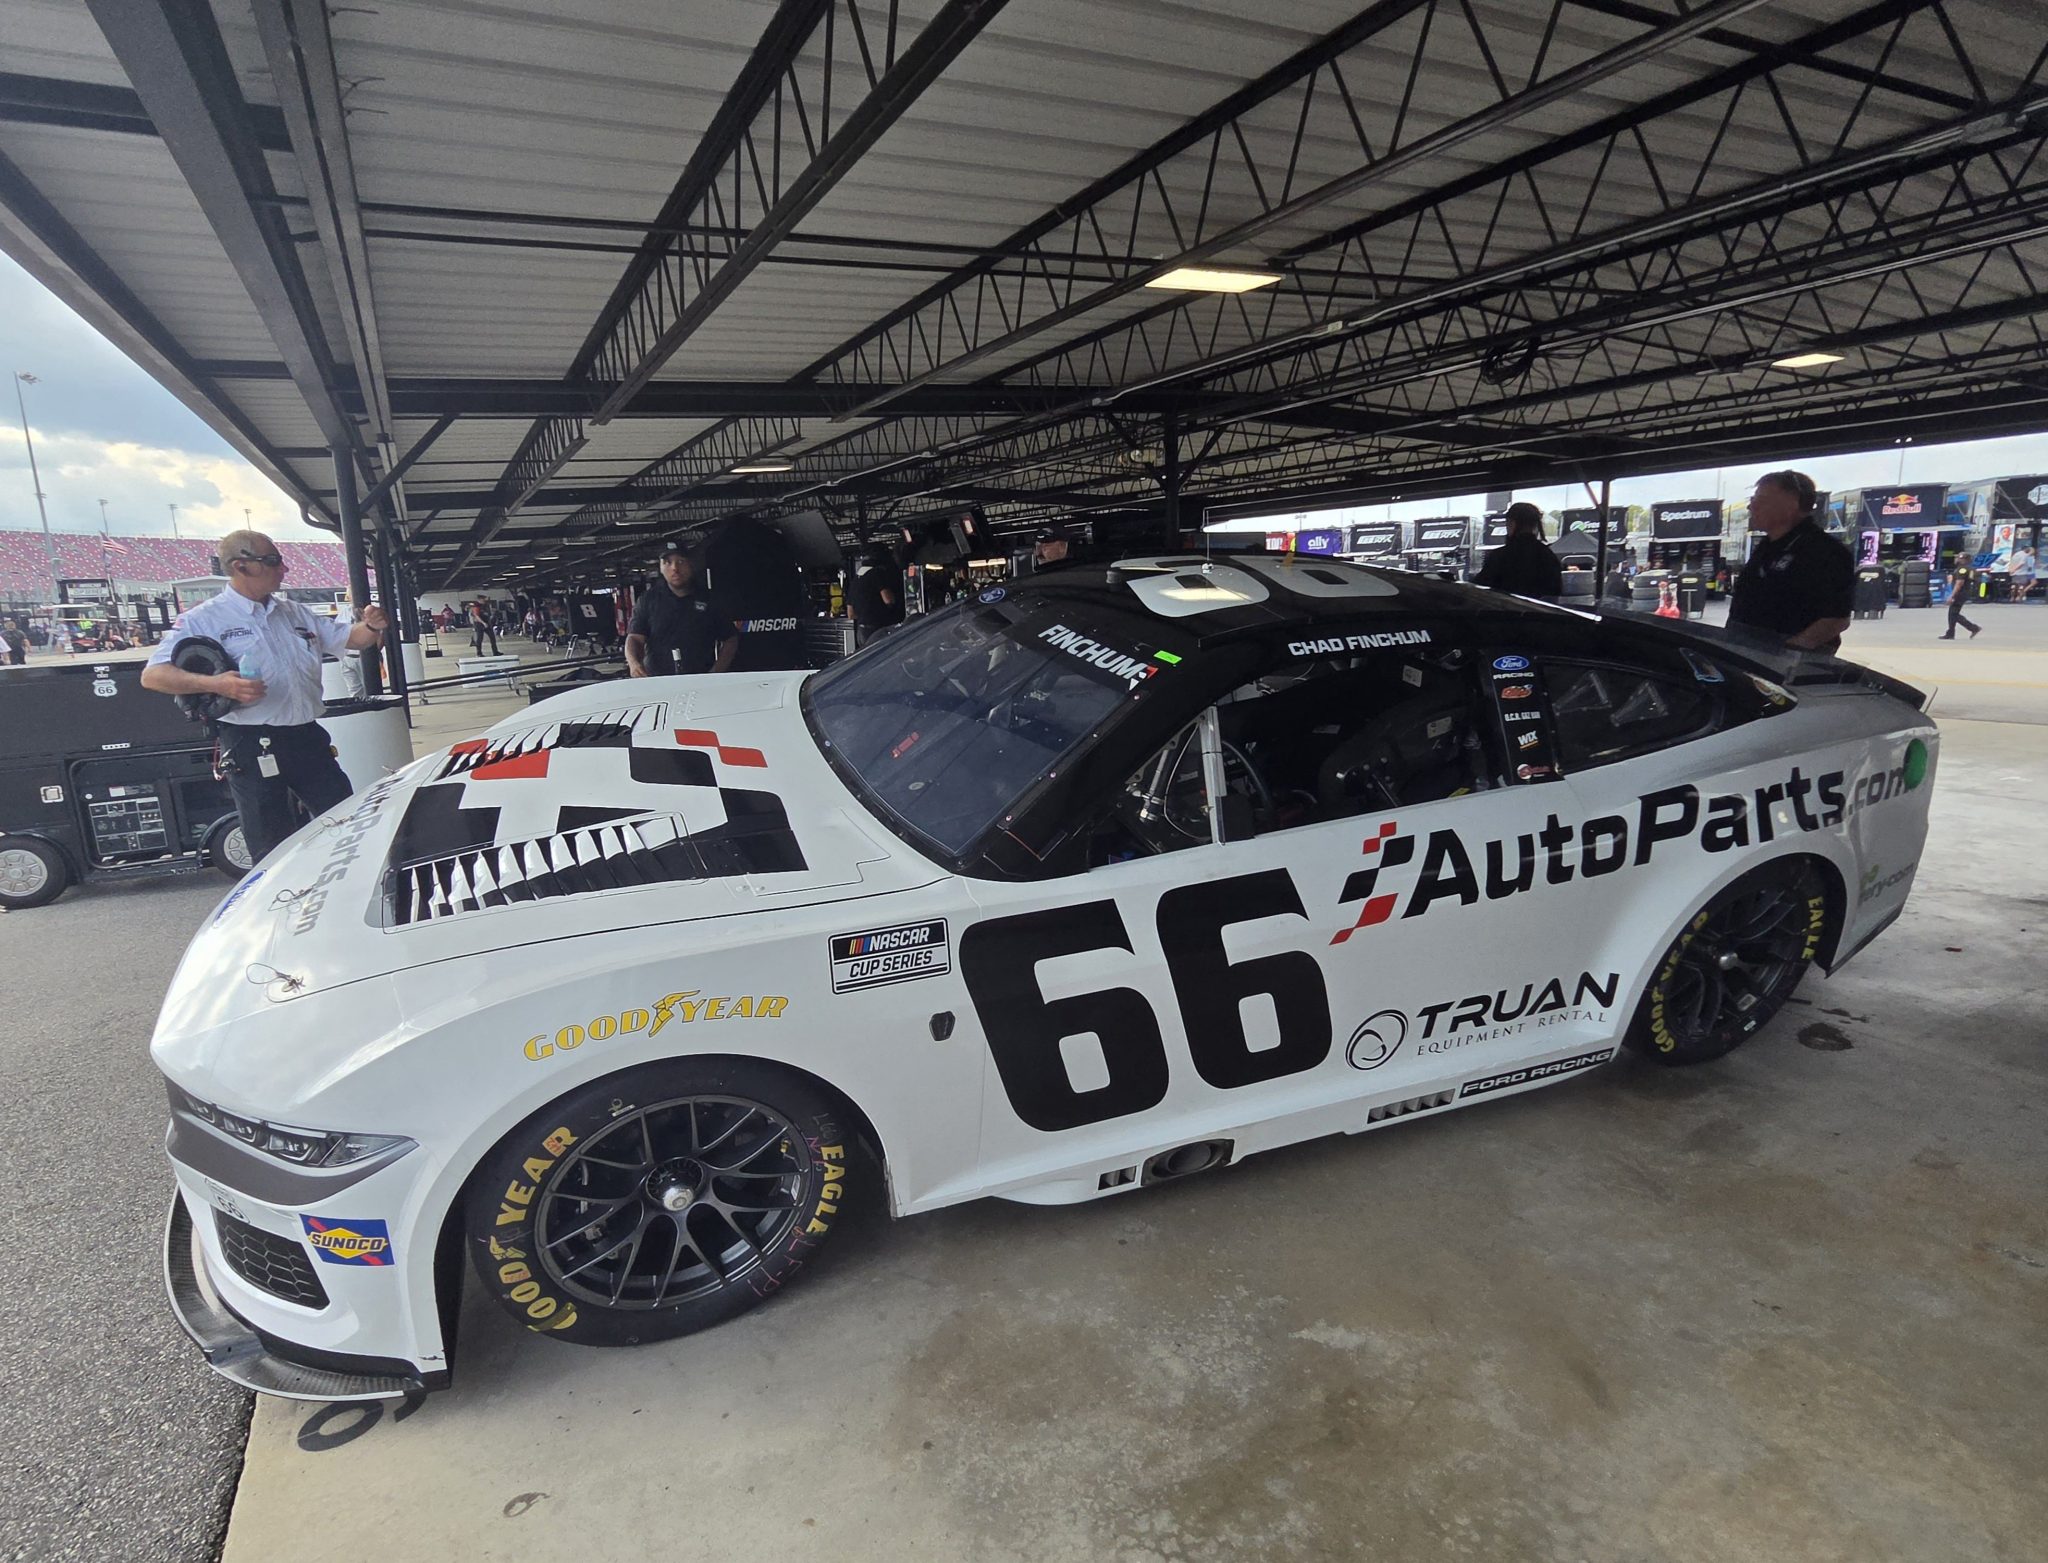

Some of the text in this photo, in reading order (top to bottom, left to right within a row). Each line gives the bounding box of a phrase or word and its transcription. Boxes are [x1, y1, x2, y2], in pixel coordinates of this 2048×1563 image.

[1660, 510, 1710, 522] Spectrum
[1307, 536, 1329, 549] ally
[580, 604, 598, 618] 8
[748, 618, 797, 632] NASCAR
[1038, 624, 1149, 680] FINCHUM
[1288, 629, 1431, 657] CHAD FINCHUM
[98, 686, 113, 695] 66
[1518, 731, 1538, 745] WIX
[869, 927, 930, 952] NASCAR
[850, 950, 933, 978] CUP SERIES
[959, 867, 1333, 1132] 66
[1416, 971, 1620, 1039] TRUAN
[1417, 1010, 1607, 1056] EQUIPMENT RENTAL
[1462, 1050, 1612, 1094] FORD RACING
[217, 1195, 245, 1220] 66
[310, 1234, 384, 1251] SUNOCO
